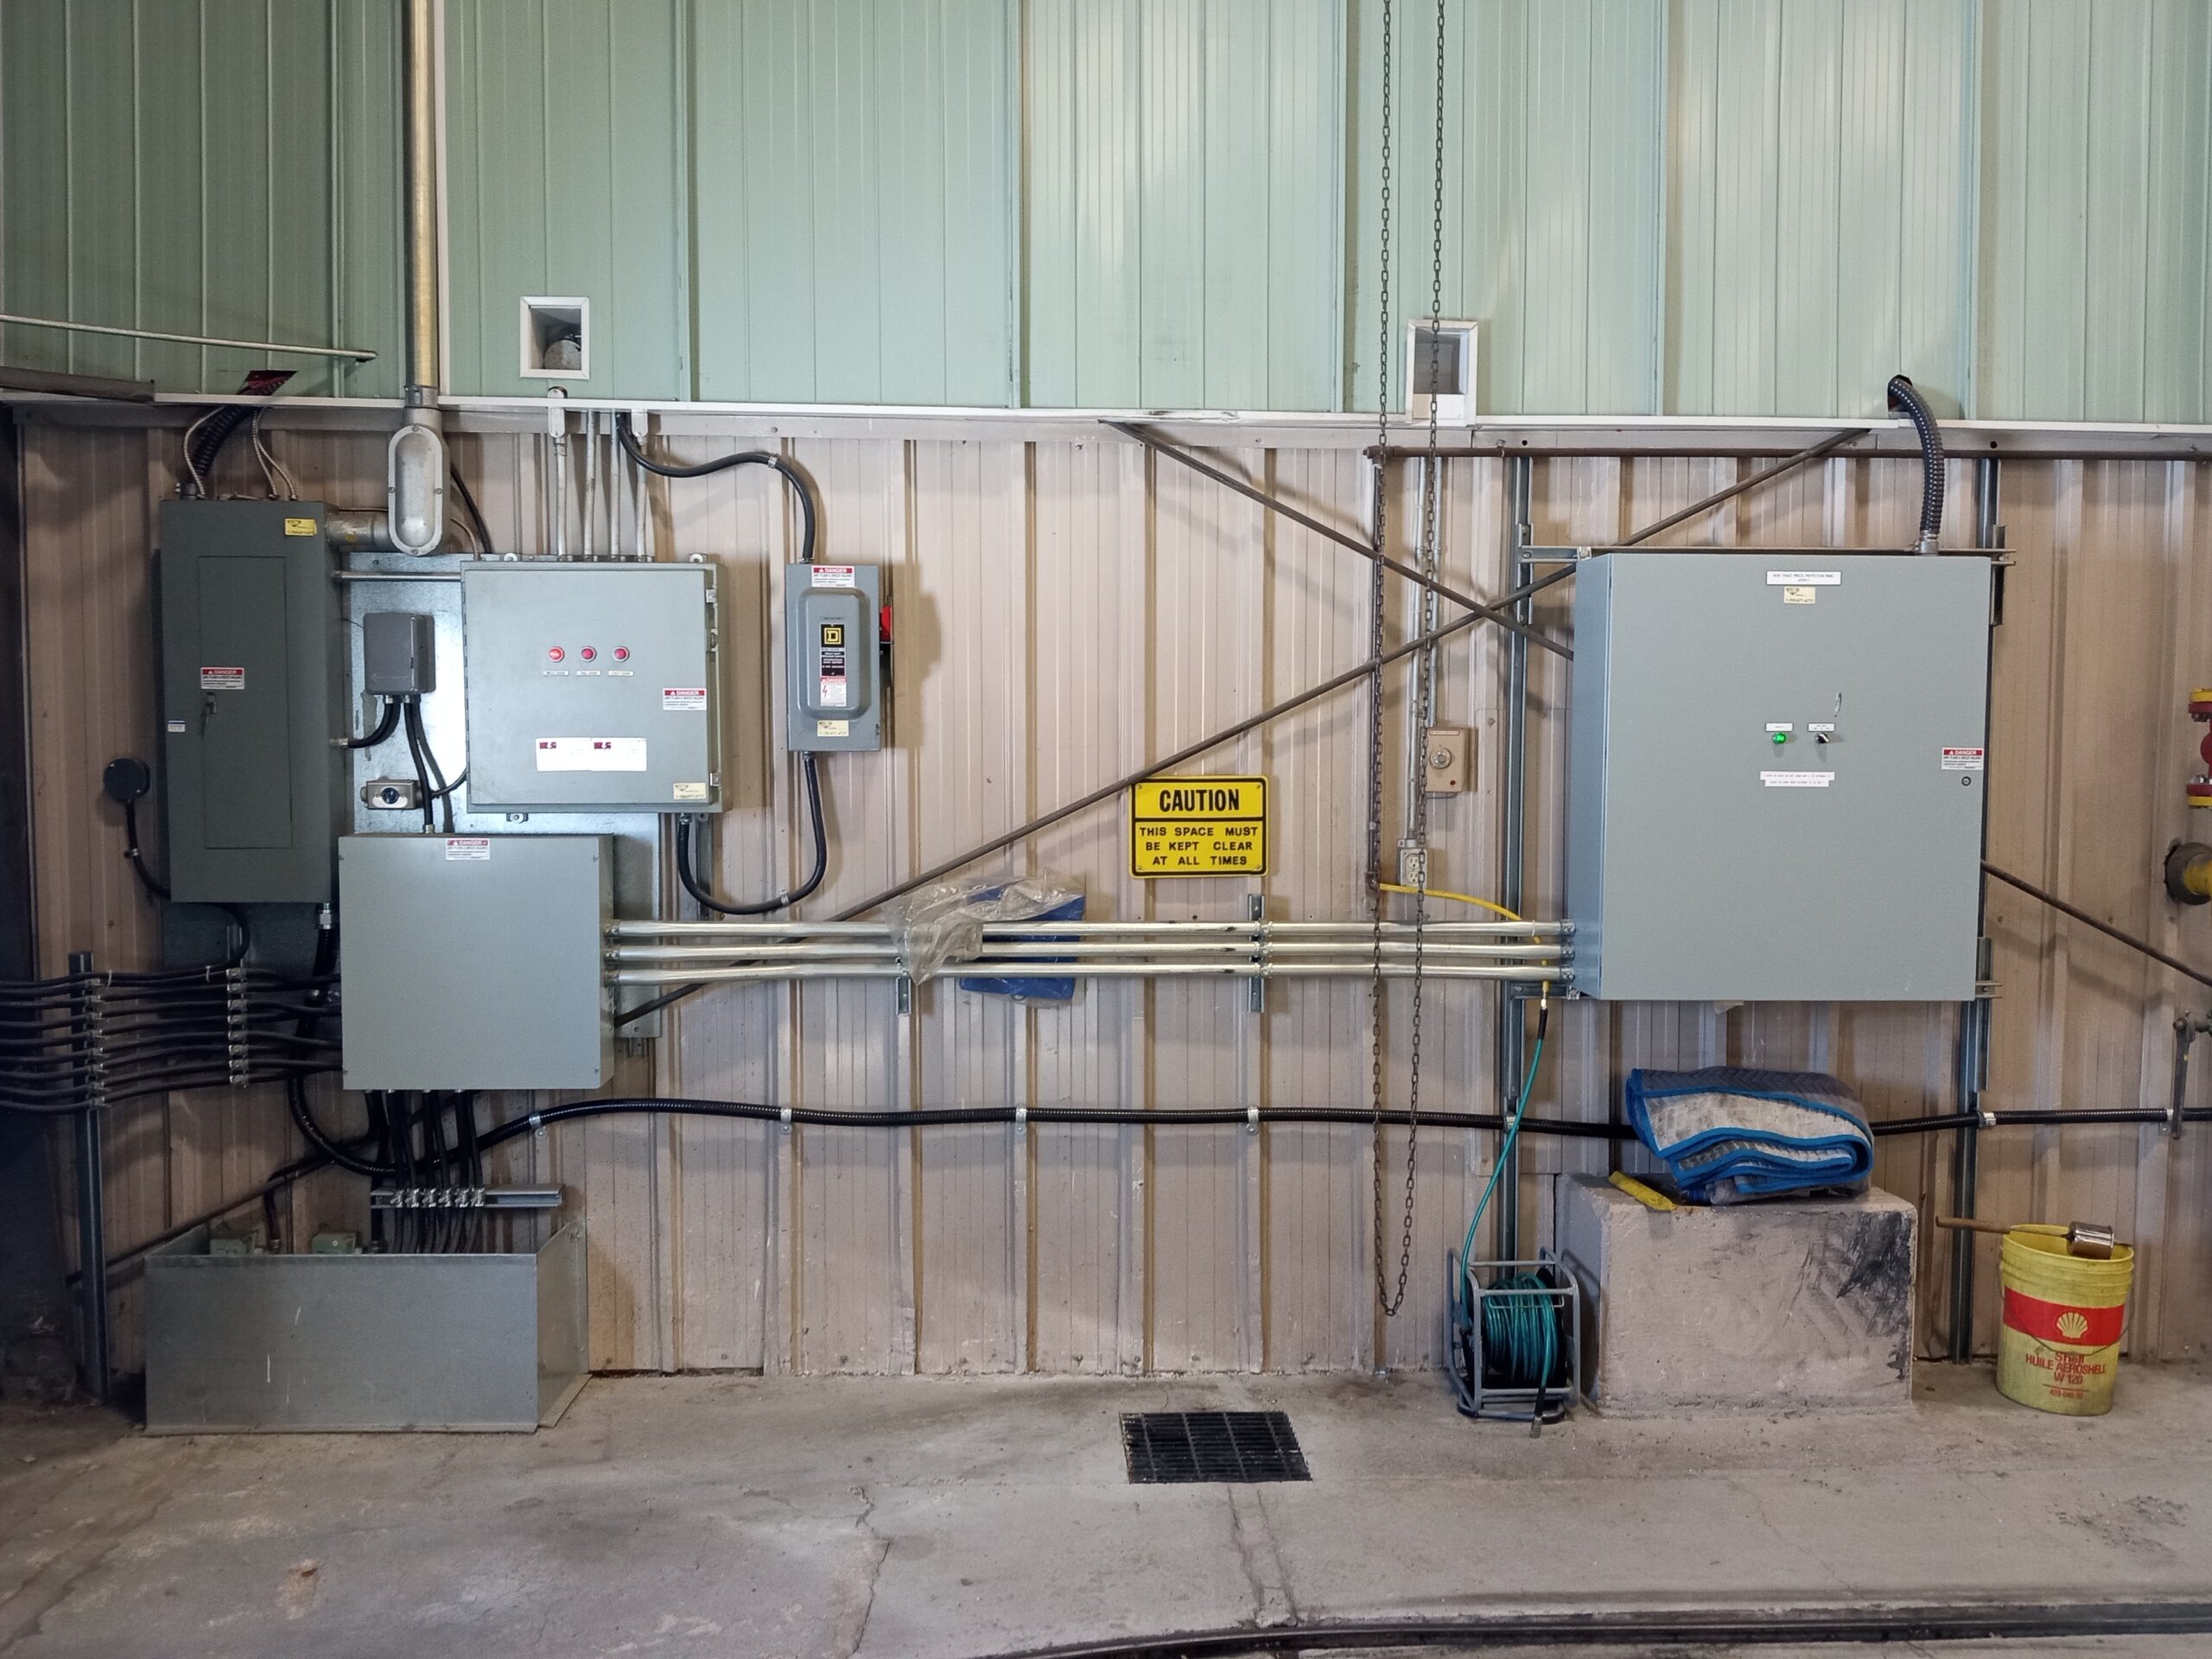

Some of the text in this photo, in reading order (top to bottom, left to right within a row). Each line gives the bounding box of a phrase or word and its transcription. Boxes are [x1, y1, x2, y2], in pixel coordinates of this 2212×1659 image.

[1160, 789, 1239, 812] CAUTION
[1140, 827, 1258, 836] THIS SPACE MUST
[1146, 842, 1252, 851] BE KEPT CLEAR
[1153, 856, 1247, 865] AT ALL TIMES
[2025, 1353, 2106, 1375] HUILE AEROSHELL
[2054, 1372, 2083, 1384] W 120
